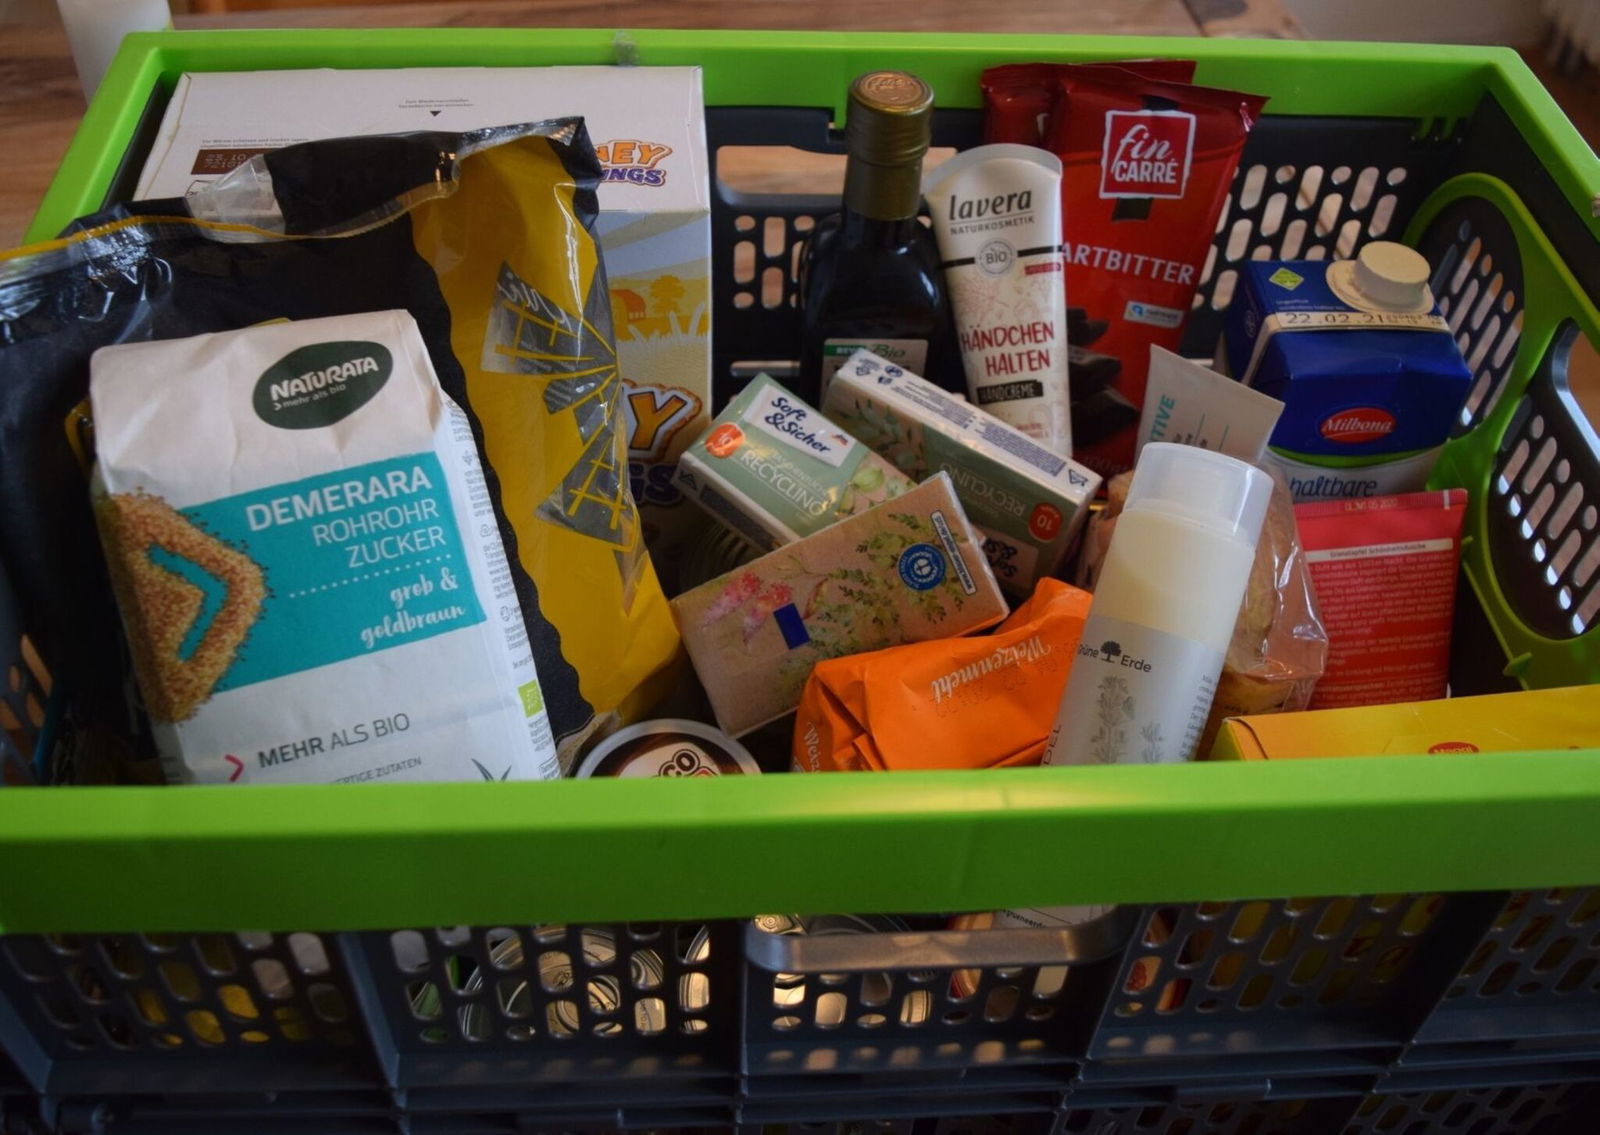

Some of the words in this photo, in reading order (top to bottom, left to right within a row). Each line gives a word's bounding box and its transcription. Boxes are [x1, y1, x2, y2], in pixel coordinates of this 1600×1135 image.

[1111, 124, 1173, 174] fin
[1114, 157, 1179, 184] CARRÉ
[949, 190, 1032, 221] lavera
[949, 216, 1035, 235] NATURKOSMETIK
[960, 320, 1055, 354] HÄNDCHEN
[984, 348, 1051, 377] HALTEN
[269, 356, 380, 401] NATURATA
[311, 389, 330, 402] als
[328, 383, 348, 396] bio
[980, 382, 1035, 402] HANDCREME
[771, 396, 807, 422] Soft
[764, 411, 831, 454] &Sicher
[1322, 417, 1393, 434] Milbona
[739, 449, 830, 516] RECYCLING
[1289, 475, 1378, 498] haltbare
[245, 465, 432, 532] DEMERARA
[312, 497, 440, 547] ROHROHR
[1036, 514, 1053, 531] 10
[345, 525, 447, 569] ZUCKER
[390, 571, 434, 609] grob
[438, 566, 460, 591] &
[360, 602, 466, 649] goldbraun
[1120, 654, 1152, 673] Erde
[258, 736, 325, 769] MEHR
[330, 723, 370, 750] ALS
[371, 712, 411, 738] BIO
[375, 756, 423, 778] ZUTATEN
